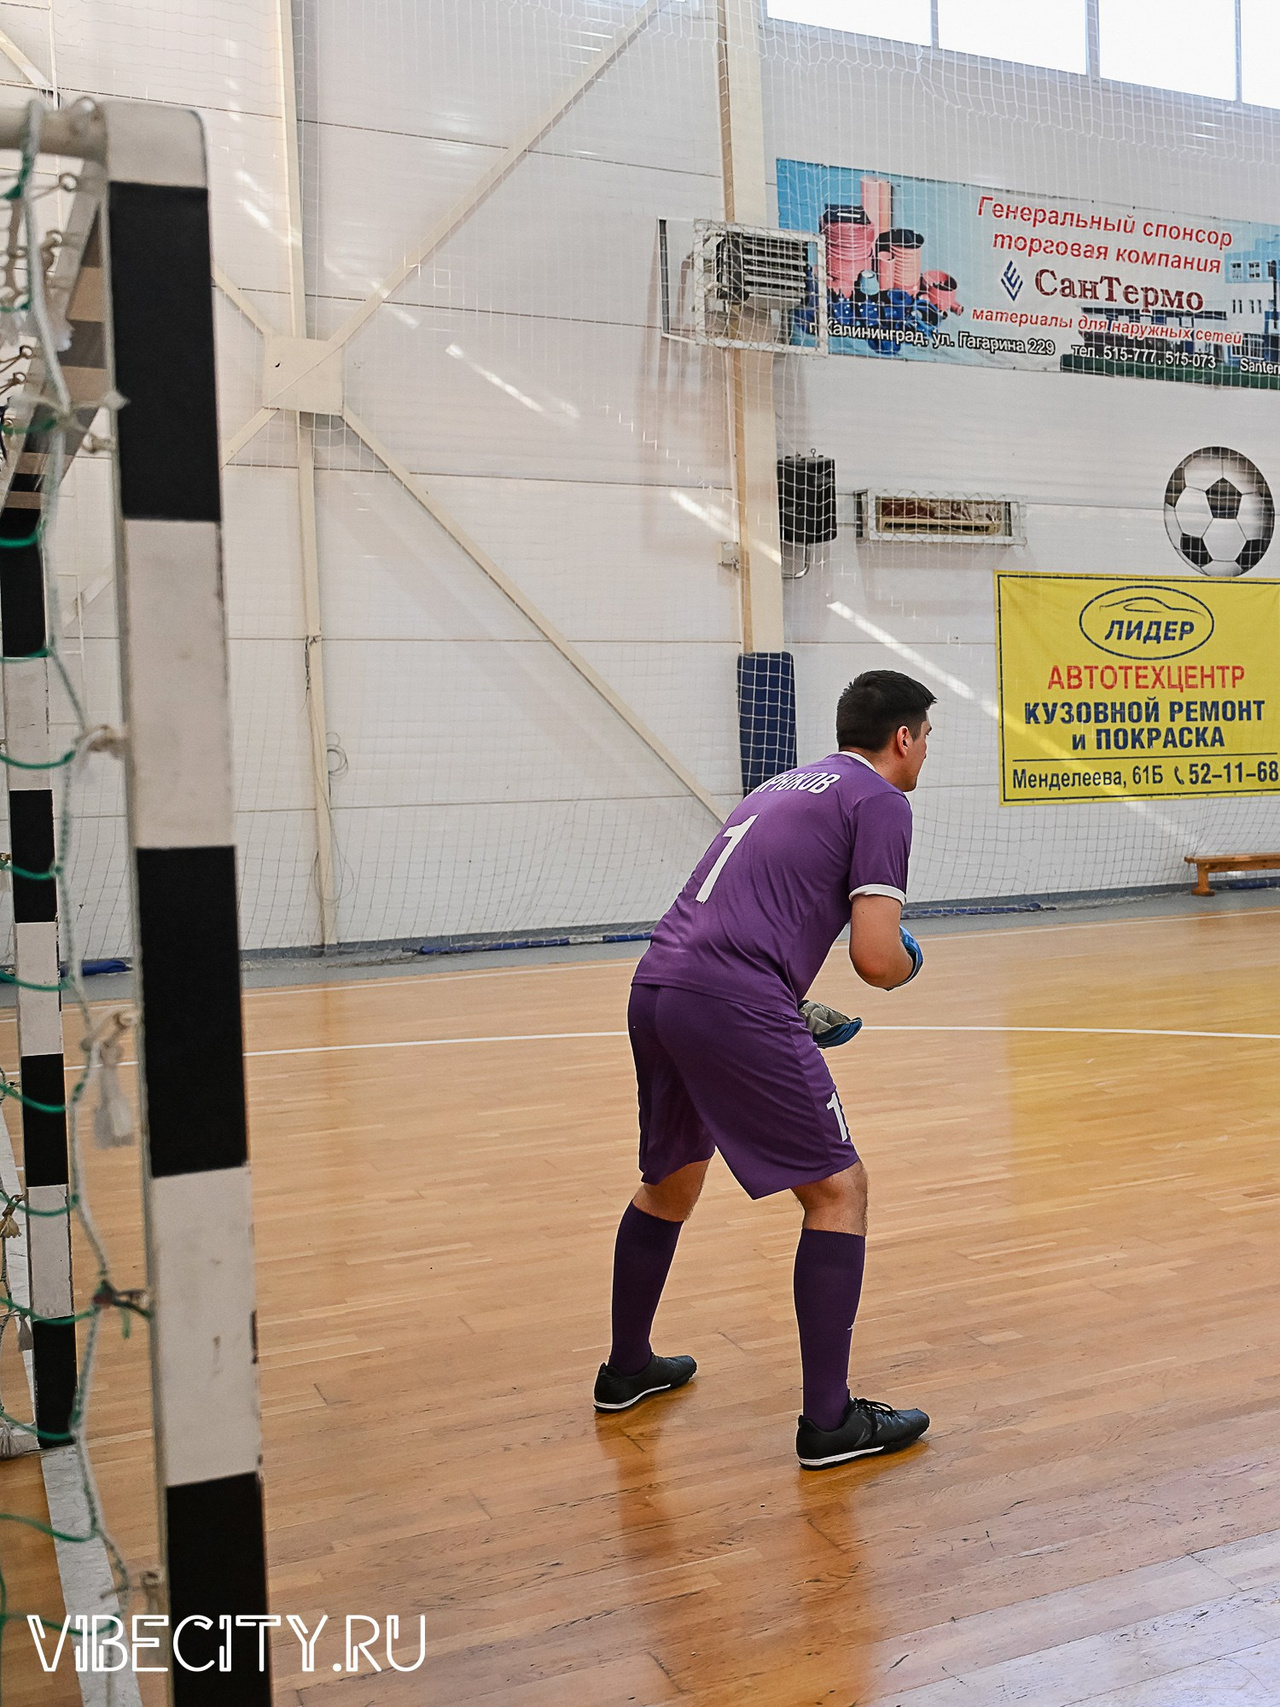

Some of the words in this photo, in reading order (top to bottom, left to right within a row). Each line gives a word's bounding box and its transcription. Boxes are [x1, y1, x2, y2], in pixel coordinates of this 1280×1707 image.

[977, 196, 1136, 234] Генеральный
[1142, 221, 1233, 250] спонсор
[992, 232, 1109, 260] торговая
[1116, 247, 1222, 274] компания
[1034, 268, 1204, 314] СанТермо
[972, 308, 1073, 328] материалы
[1078, 314, 1107, 331] для
[1110, 319, 1193, 340] наружных
[1196, 330, 1243, 345] сетей
[932, 330, 954, 348] ул.
[958, 332, 1025, 354] Гагарина
[1027, 338, 1056, 355] 229
[1072, 344, 1099, 359] тел.
[1103, 346, 1163, 367] 515-777,
[1166, 353, 1217, 370] 515-073
[1104, 620, 1195, 644] ЛИДЕР
[1047, 664, 1246, 693] АВТОТЕХЦЕНТР
[1024, 696, 1160, 724] КУЗОВНОЙ
[1169, 699, 1266, 723] РЕМОНТ
[1072, 732, 1086, 750] и
[1096, 726, 1226, 750] ПОКРАСКА
[1013, 768, 1127, 791] Менделеева,
[1132, 765, 1164, 785] 61Б
[1188, 760, 1280, 785] 52-11-68
[695, 813, 759, 905] 1
[826, 1091, 849, 1143] 1
